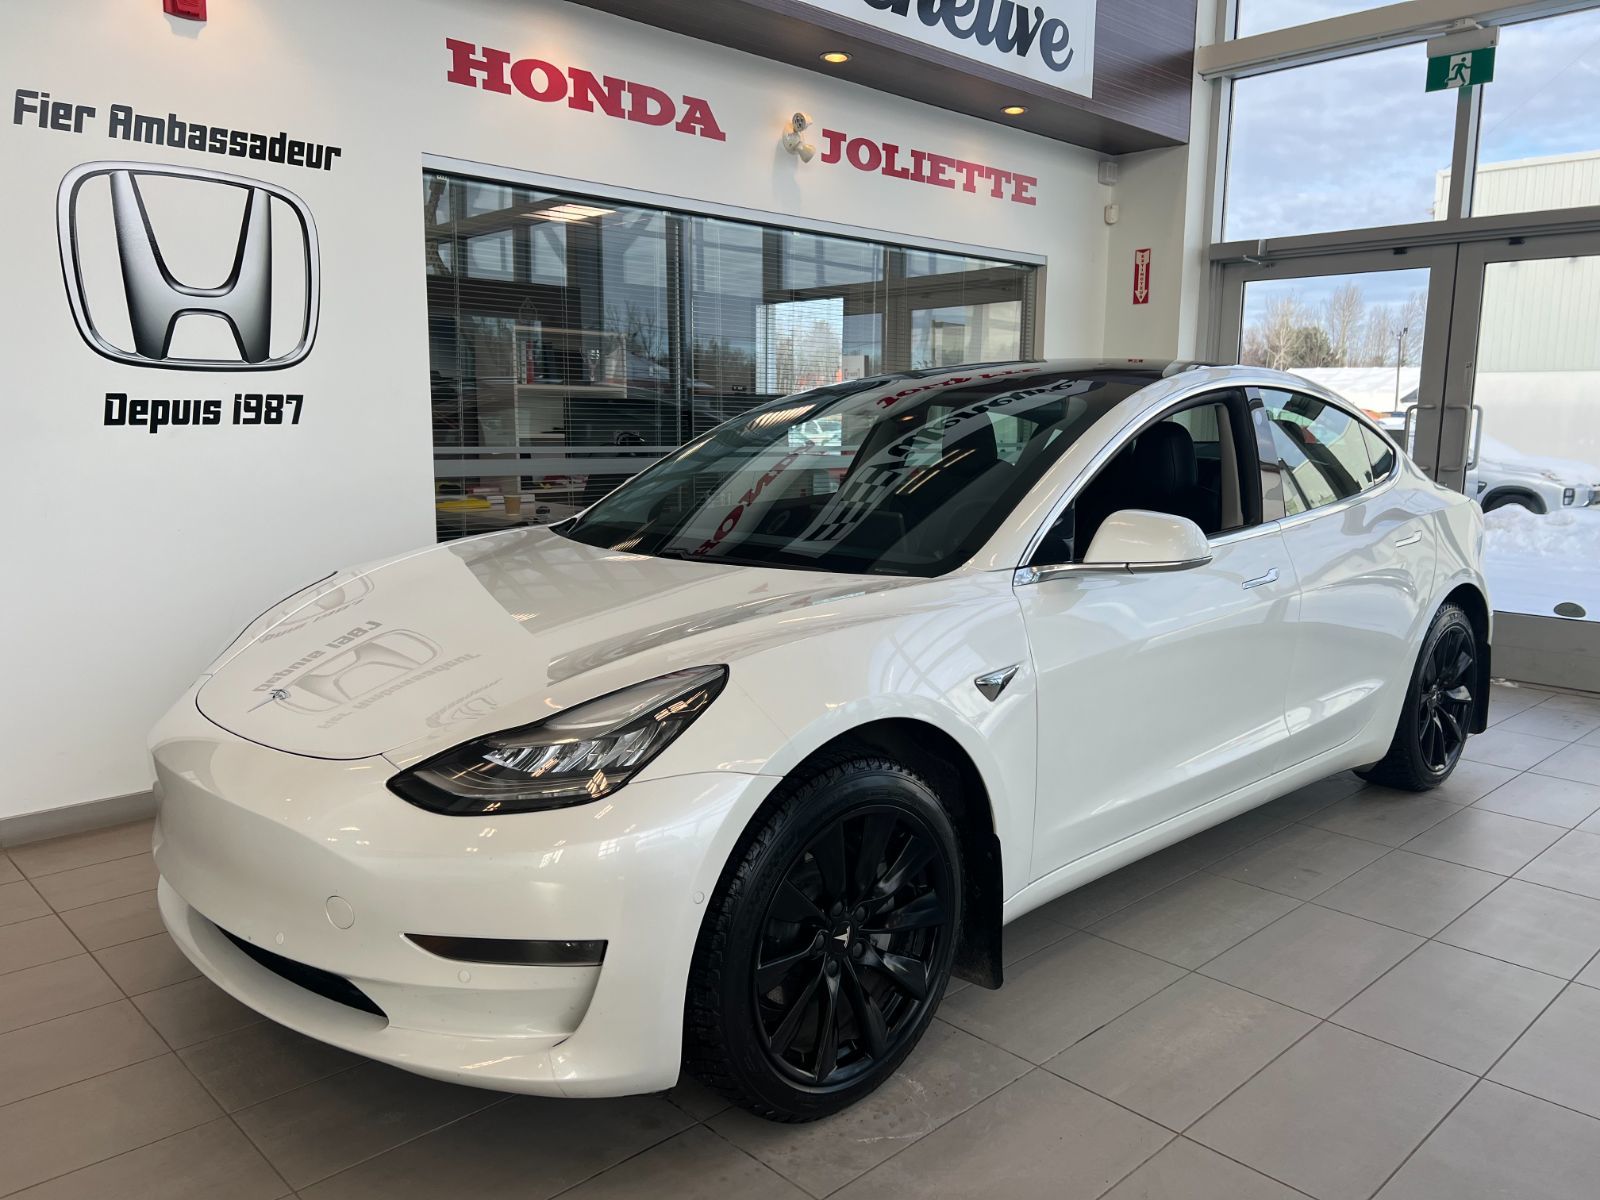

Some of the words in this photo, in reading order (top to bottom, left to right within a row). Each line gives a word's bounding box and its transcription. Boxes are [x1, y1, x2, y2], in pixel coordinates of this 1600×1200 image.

[13, 88, 96, 134] Fier
[108, 104, 342, 171] Ambassadeur
[446, 38, 726, 141] HONDA
[821, 129, 1037, 206] JOLIETTE
[104, 393, 222, 434] Depuis
[232, 394, 304, 425] 1987
